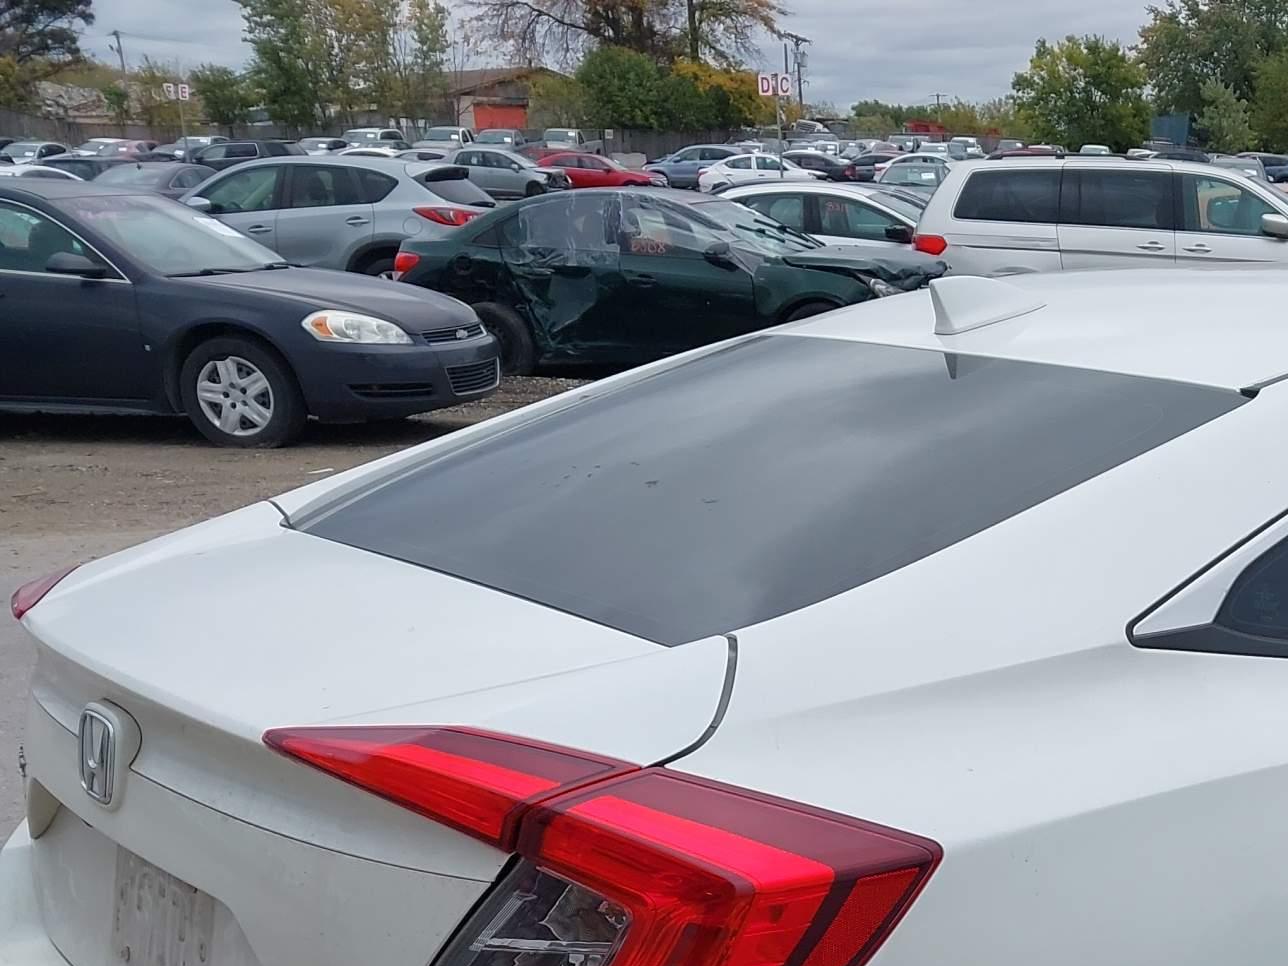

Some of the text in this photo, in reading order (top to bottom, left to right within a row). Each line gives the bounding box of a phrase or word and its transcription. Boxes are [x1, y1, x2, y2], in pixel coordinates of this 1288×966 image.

[180, 85, 187, 98] E
[761, 77, 790, 93] D C
